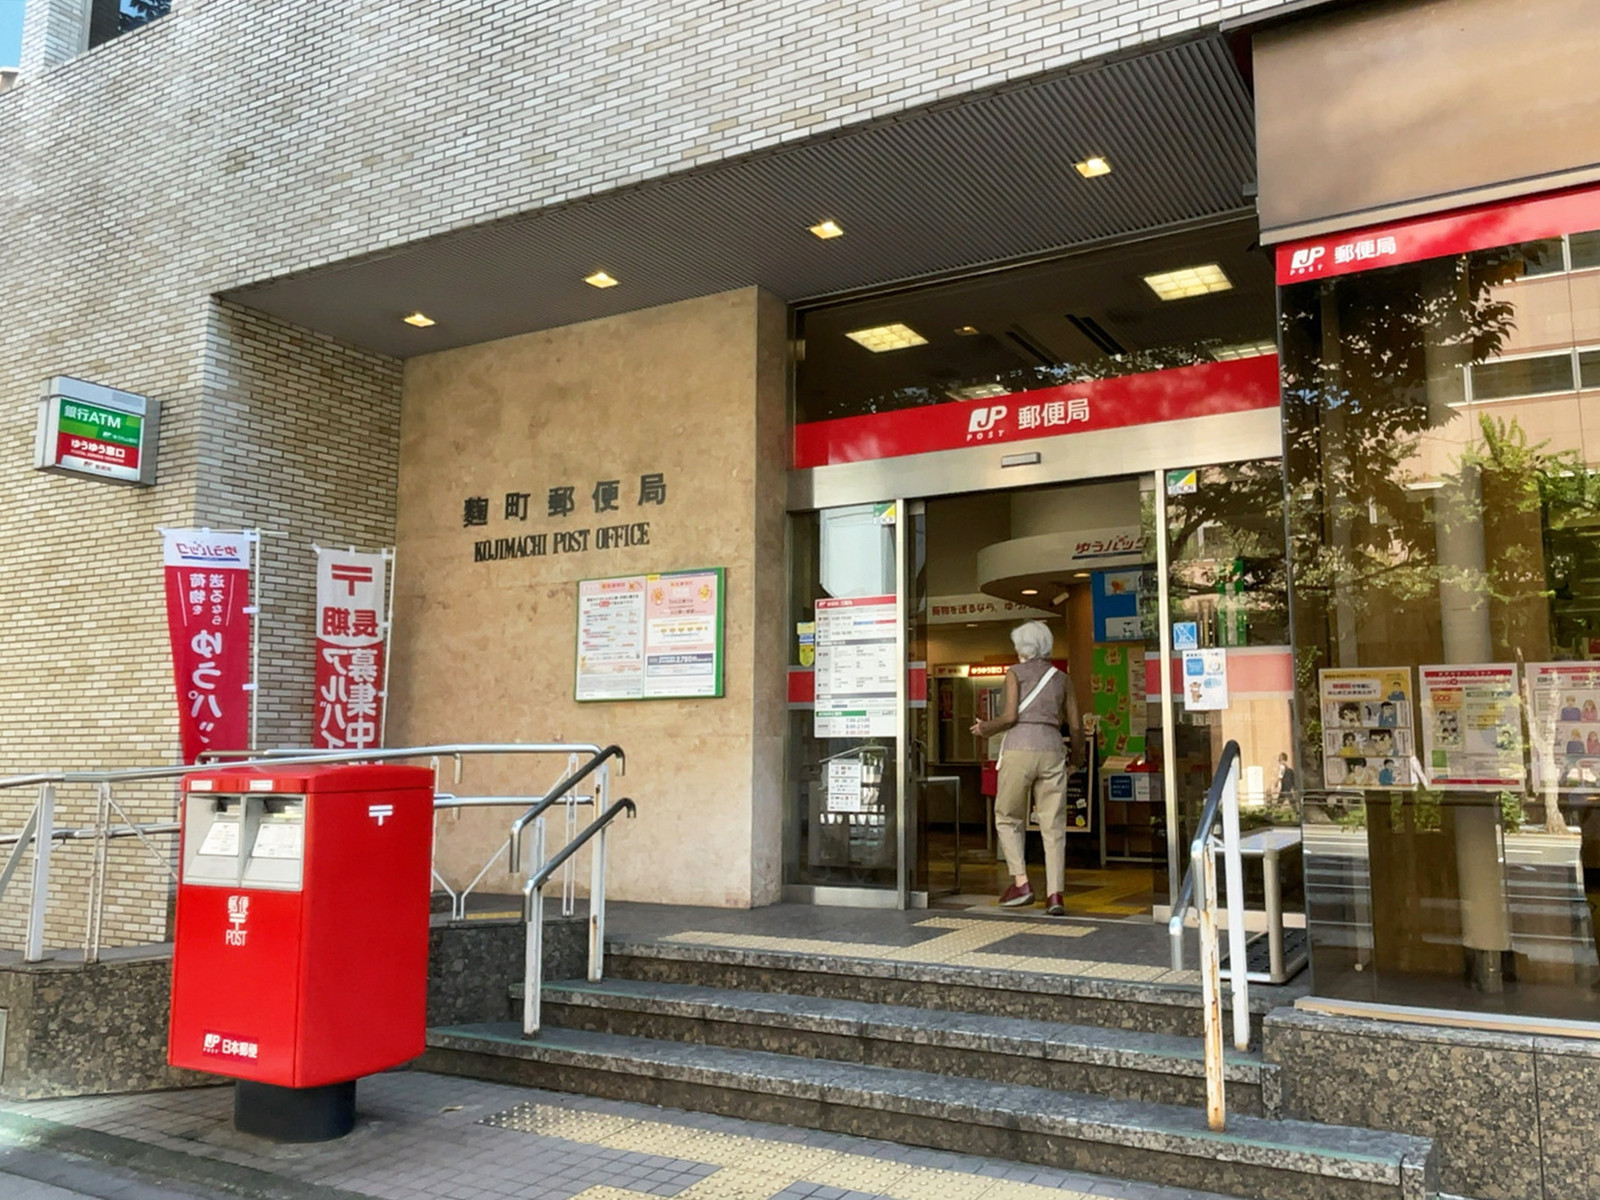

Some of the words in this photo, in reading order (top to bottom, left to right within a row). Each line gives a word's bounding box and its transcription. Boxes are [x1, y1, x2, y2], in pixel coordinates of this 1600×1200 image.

[1334, 236, 1397, 264] 郵便局
[1289, 263, 1323, 276] POST
[63, 404, 121, 429] 銀行ATM
[1017, 398, 1090, 430] 郵便局
[966, 429, 1005, 441] POST
[71, 438, 125, 459] ゆうゆう窓口
[474, 533, 547, 563] KOJIMACHI
[552, 529, 590, 554] POST
[596, 522, 650, 550] OFFICE
[1074, 535, 1151, 554] ゆうパック
[225, 930, 247, 946] POST
[222, 1039, 258, 1058] 日本郵便
